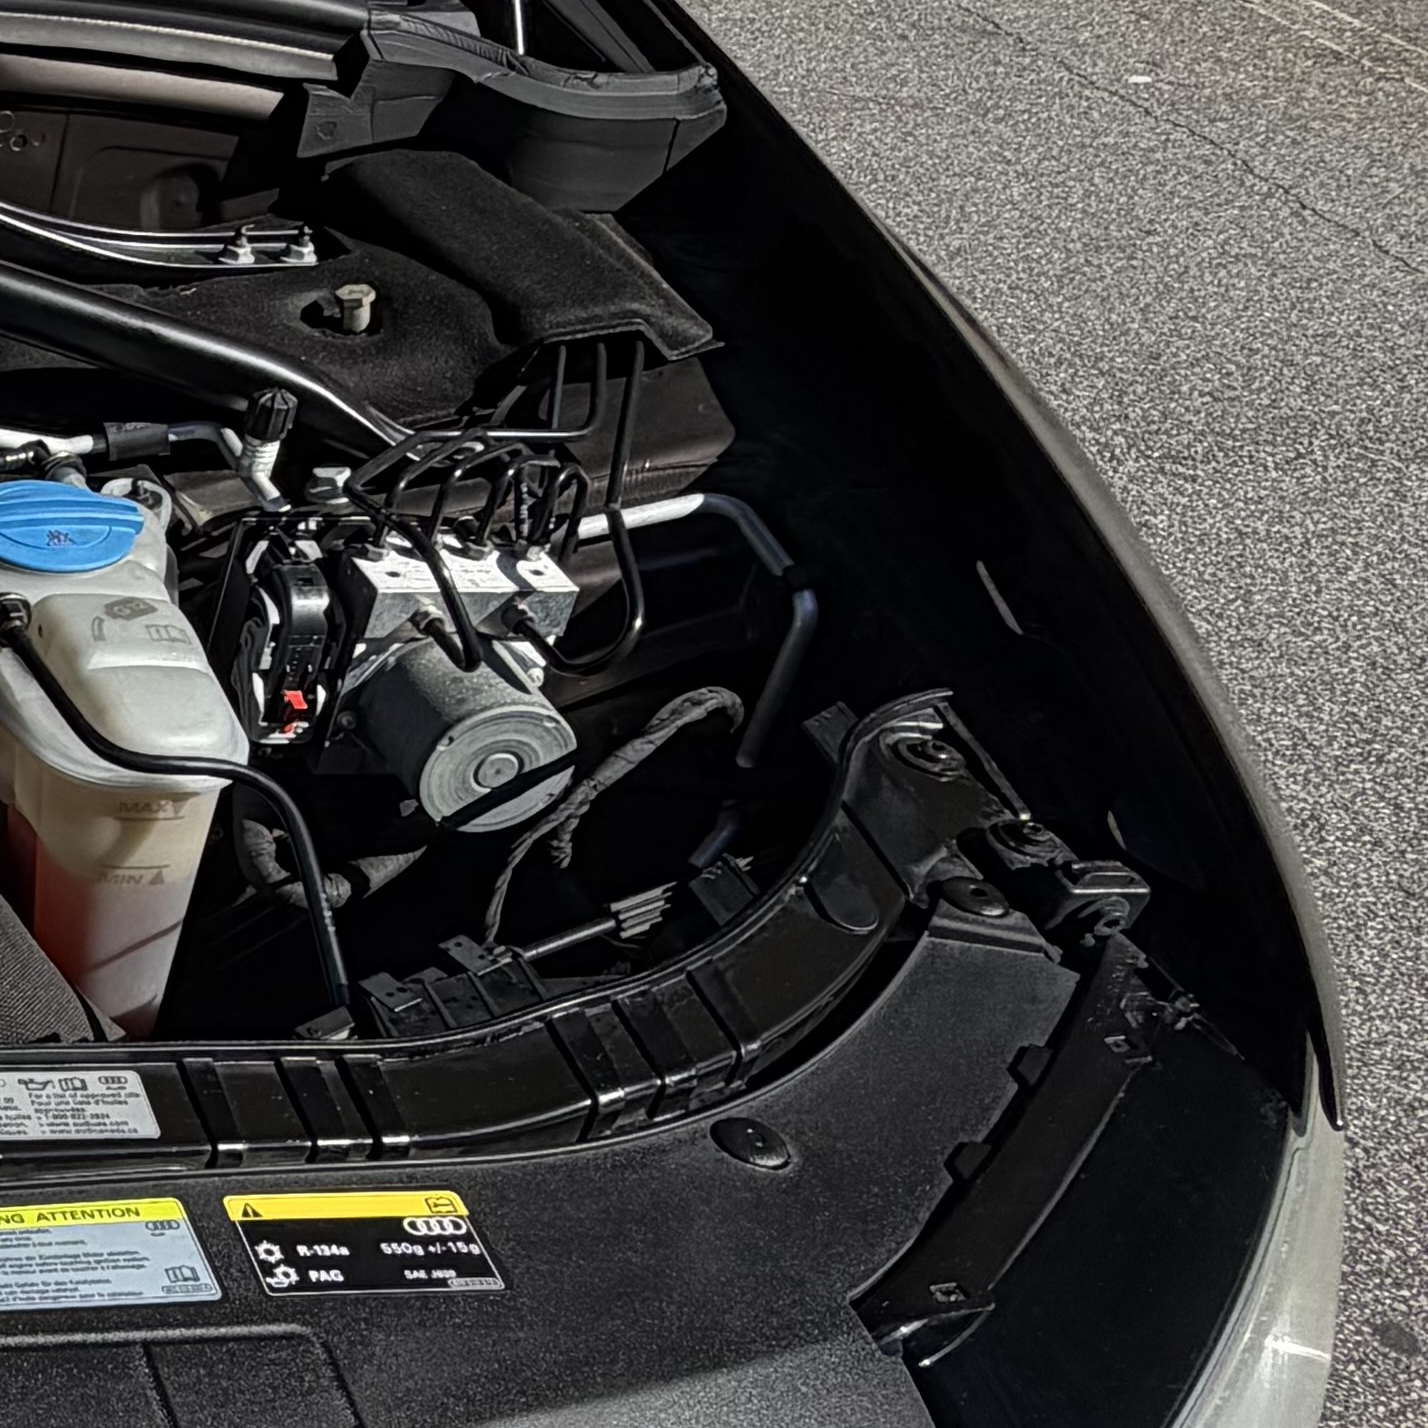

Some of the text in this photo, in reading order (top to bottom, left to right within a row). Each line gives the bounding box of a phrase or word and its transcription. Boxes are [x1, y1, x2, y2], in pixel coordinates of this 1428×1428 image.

[119, 800, 170, 814] MAX
[99, 872, 144, 885] MIN
[36, 1206, 141, 1223] ATTENTION
[296, 1245, 350, 1257] R-134a
[308, 1269, 345, 1283] PAG
